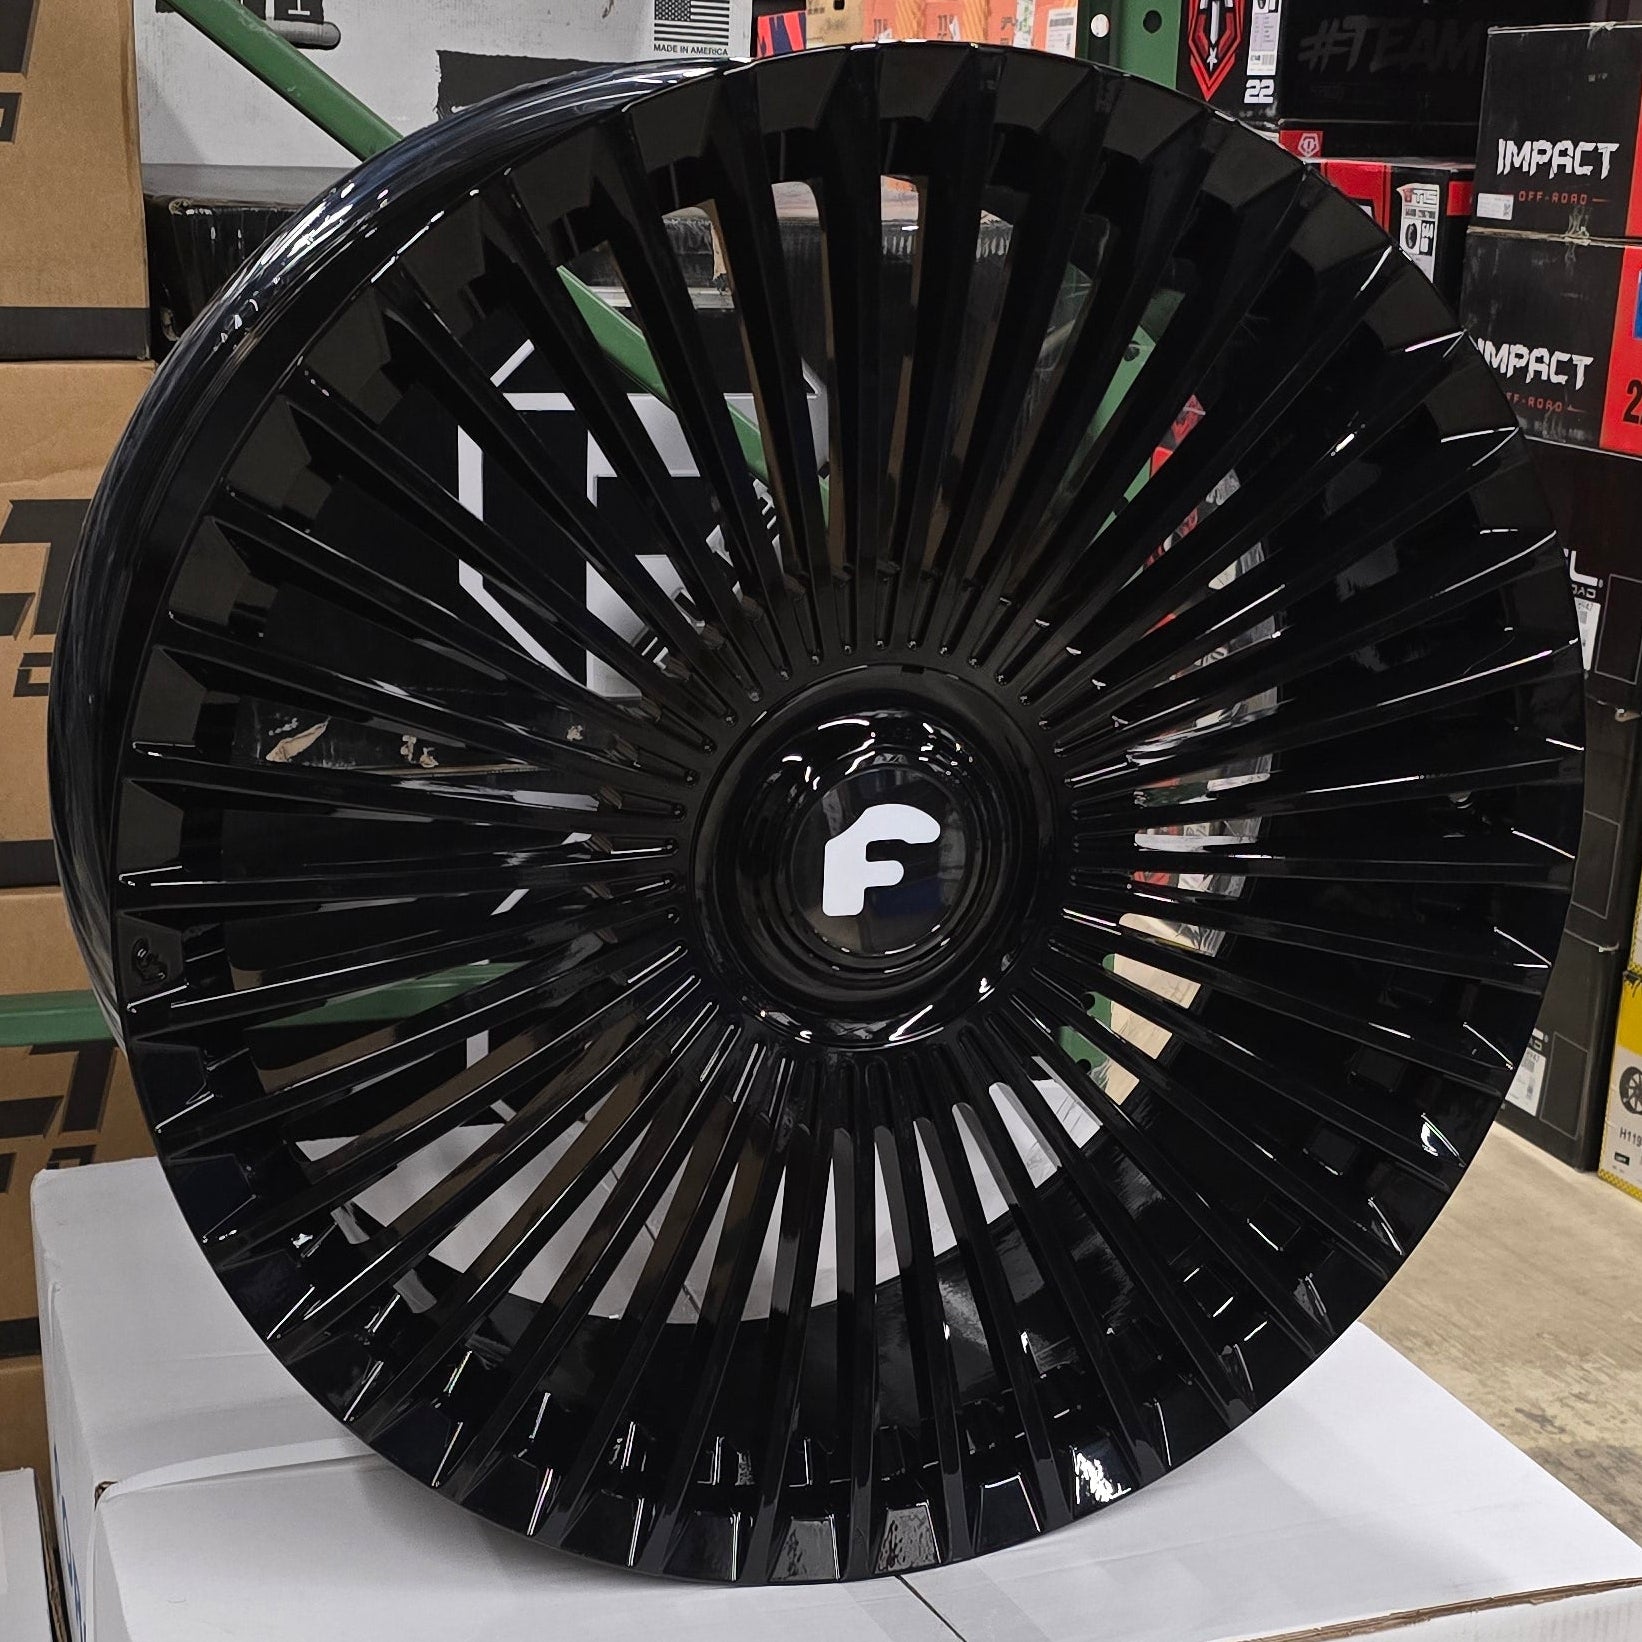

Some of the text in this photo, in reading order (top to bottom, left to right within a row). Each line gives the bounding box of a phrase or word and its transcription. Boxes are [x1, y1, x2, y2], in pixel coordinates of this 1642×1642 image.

[653, 44, 728, 56] MADE IN AMERICA
[1244, 79, 1275, 104] 22
[1497, 138, 1620, 179] IMPACT
[1519, 190, 1588, 205] OFF-ROAD
[1477, 337, 1594, 391] IMPACT
[822, 803, 941, 917] F
